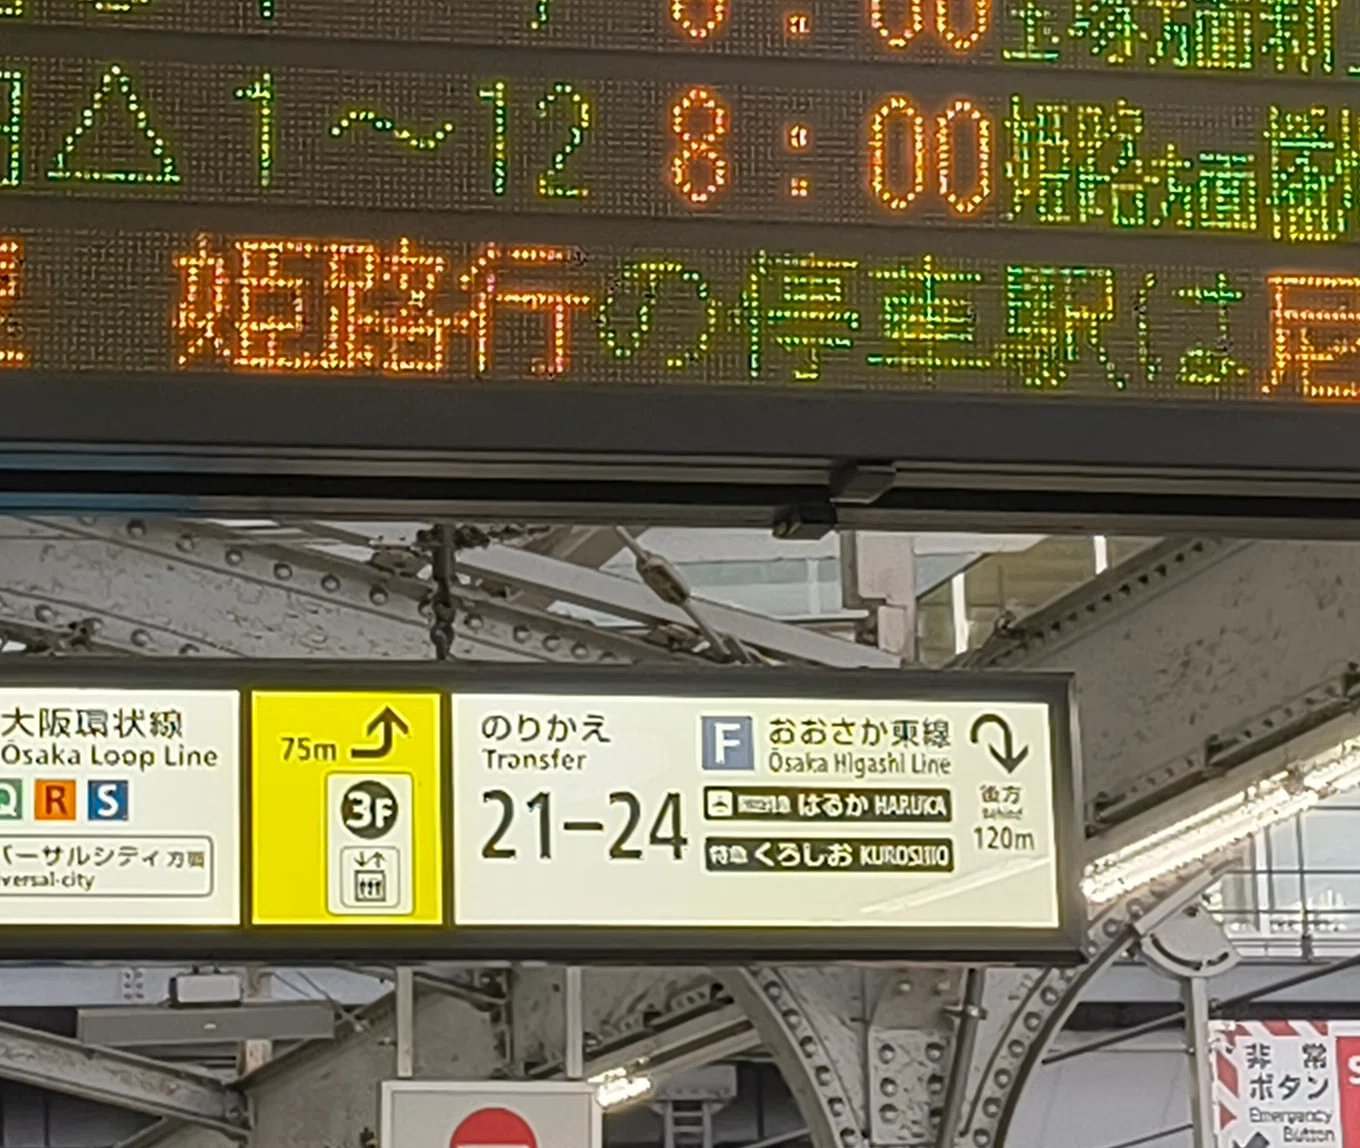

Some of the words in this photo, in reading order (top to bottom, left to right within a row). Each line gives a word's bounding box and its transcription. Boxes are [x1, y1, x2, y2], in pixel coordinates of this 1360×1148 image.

[670, 85, 993, 215] 8:00
[1, 706, 184, 740] 大阪環状線
[480, 713, 612, 744] のりかえ
[768, 716, 952, 749] おおさか東線
[90, 742, 156, 773] Loop
[164, 742, 219, 769] Line
[280, 736, 338, 763] 75m
[482, 748, 587, 771] Transfer
[714, 722, 742, 766] F
[835, 751, 905, 779] Higashi
[911, 751, 952, 776] Line
[97, 783, 120, 818] S
[345, 794, 393, 829] 3F
[797, 793, 870, 818] はるか
[973, 826, 1035, 850] 120m
[754, 842, 854, 868] くろしお
[1250, 1072, 1330, 1101] ボタン
